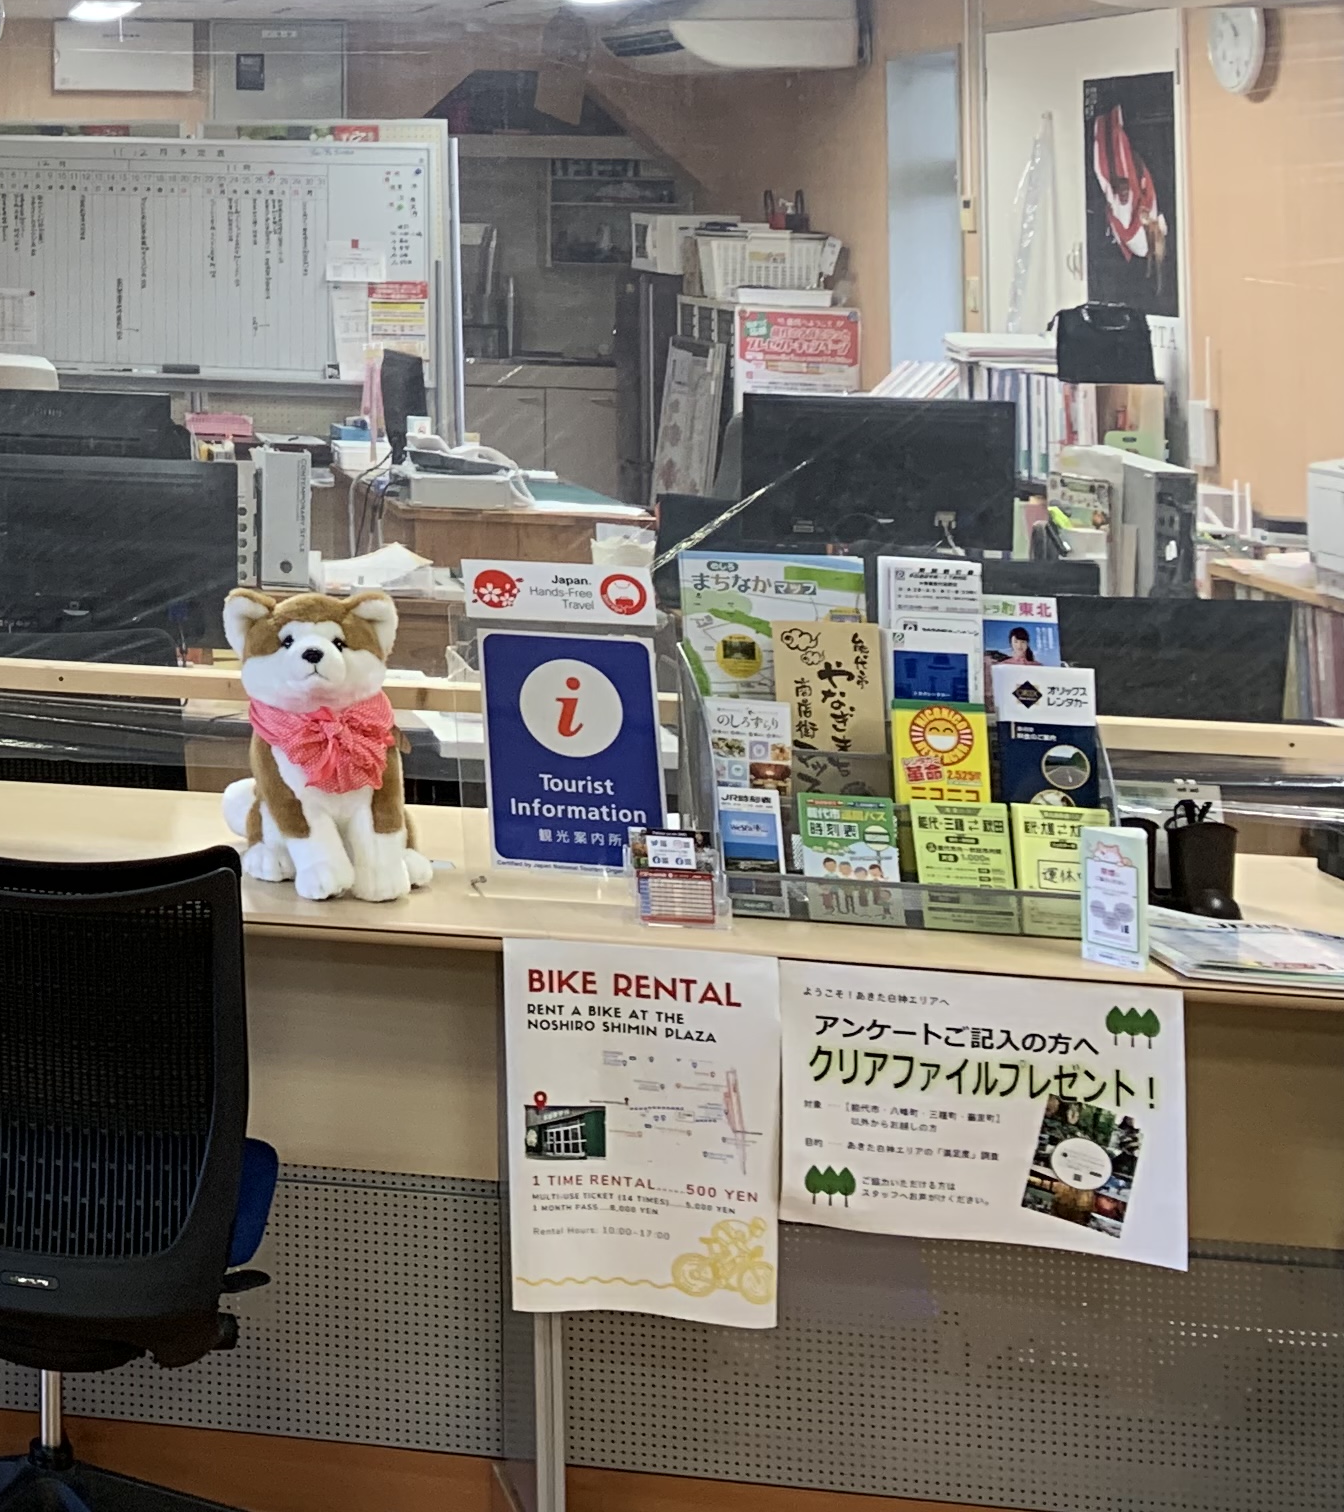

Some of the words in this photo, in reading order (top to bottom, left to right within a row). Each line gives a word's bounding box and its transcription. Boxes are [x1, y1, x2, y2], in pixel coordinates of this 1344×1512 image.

[552, 575, 592, 587] Japan.
[691, 572, 772, 594] まちなか
[529, 586, 593, 598] Hands-Free
[562, 598, 595, 610] Travel
[1018, 602, 1053, 619] 東北
[1047, 686, 1088, 696] オリックス
[1047, 697, 1089, 708] レンタカー
[539, 773, 615, 796] Tourist
[511, 798, 648, 825] Information
[538, 828, 623, 848] 観光案内所
[809, 822, 858, 838] 時刻表
[1042, 867, 1082, 885] 運休
[527, 968, 599, 996] BIKE
[613, 973, 742, 1008] RENTAL
[527, 1003, 564, 1016] RENT
[571, 1005, 582, 1017] A
[588, 1005, 622, 1019] BIKE
[628, 1008, 650, 1021] AT
[656, 1011, 685, 1025] THE
[527, 1019, 596, 1033] NOSHIRO
[602, 1021, 658, 1038] SHIMIN
[664, 1026, 718, 1044] PLAZA
[814, 1014, 1100, 1057] アンケートご記入の方へ
[808, 1044, 1157, 1110] クリアファイルプレゼント!
[532, 1174, 541, 1187] 1
[547, 1174, 584, 1187] TIME
[590, 1174, 656, 1190] RENTAL
[725, 1188, 760, 1203] YEN
[541, 1204, 572, 1212] MONTH
[640, 1206, 659, 1215] YEN
[583, 1192, 614, 1201] TICKET
[716, 1205, 737, 1215] YEN
[533, 1226, 564, 1237] Rental
